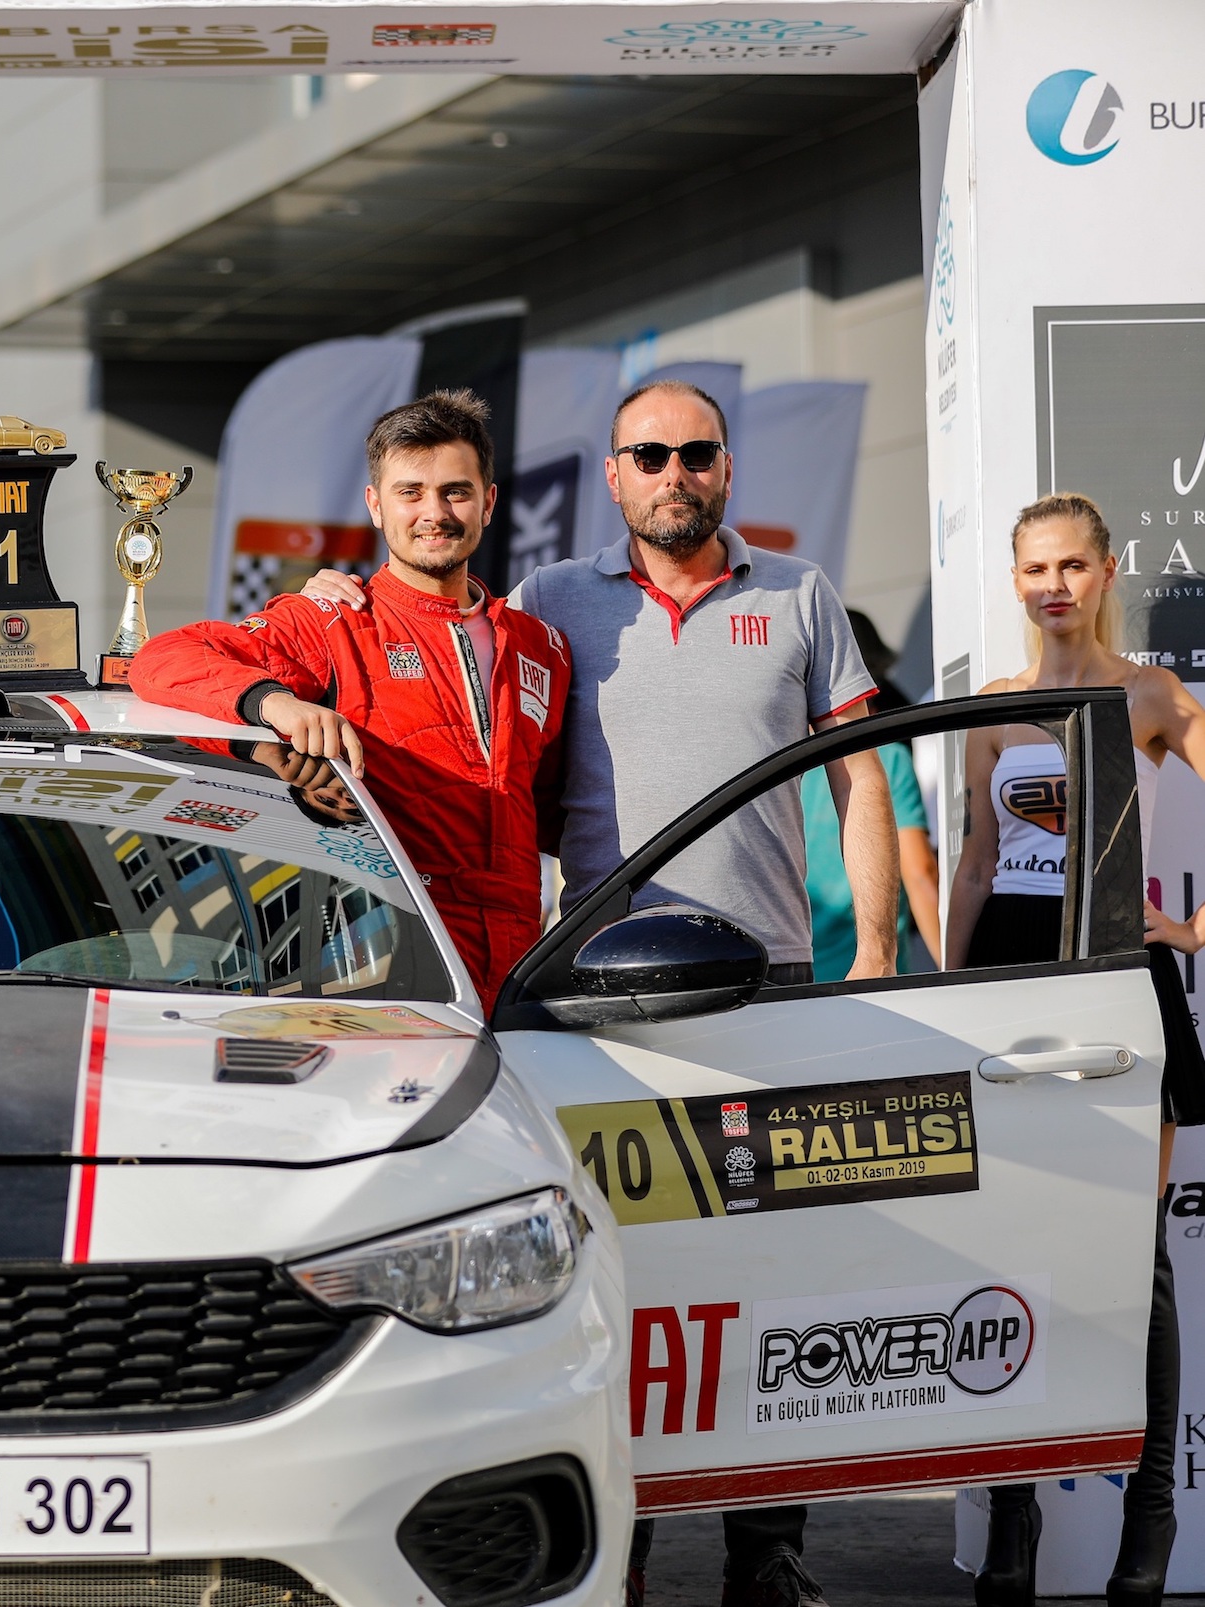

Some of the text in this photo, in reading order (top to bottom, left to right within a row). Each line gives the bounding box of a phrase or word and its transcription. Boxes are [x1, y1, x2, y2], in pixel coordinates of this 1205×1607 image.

[6, 621, 22, 635] FIAT
[730, 615, 771, 647] FIAT
[522, 658, 547, 698] FIAT
[885, 1091, 967, 1113] BURSA
[580, 1127, 652, 1203] 10
[727, 1170, 755, 1179] NİLÜFER
[807, 1160, 926, 1185] 01-02-03 Kasım 2019
[757, 1312, 1021, 1393] POWER APP
[756, 1384, 946, 1423] EN GÜÇLÜ MÜZİK PLATFORMU
[25, 1476, 133, 1536] 302
